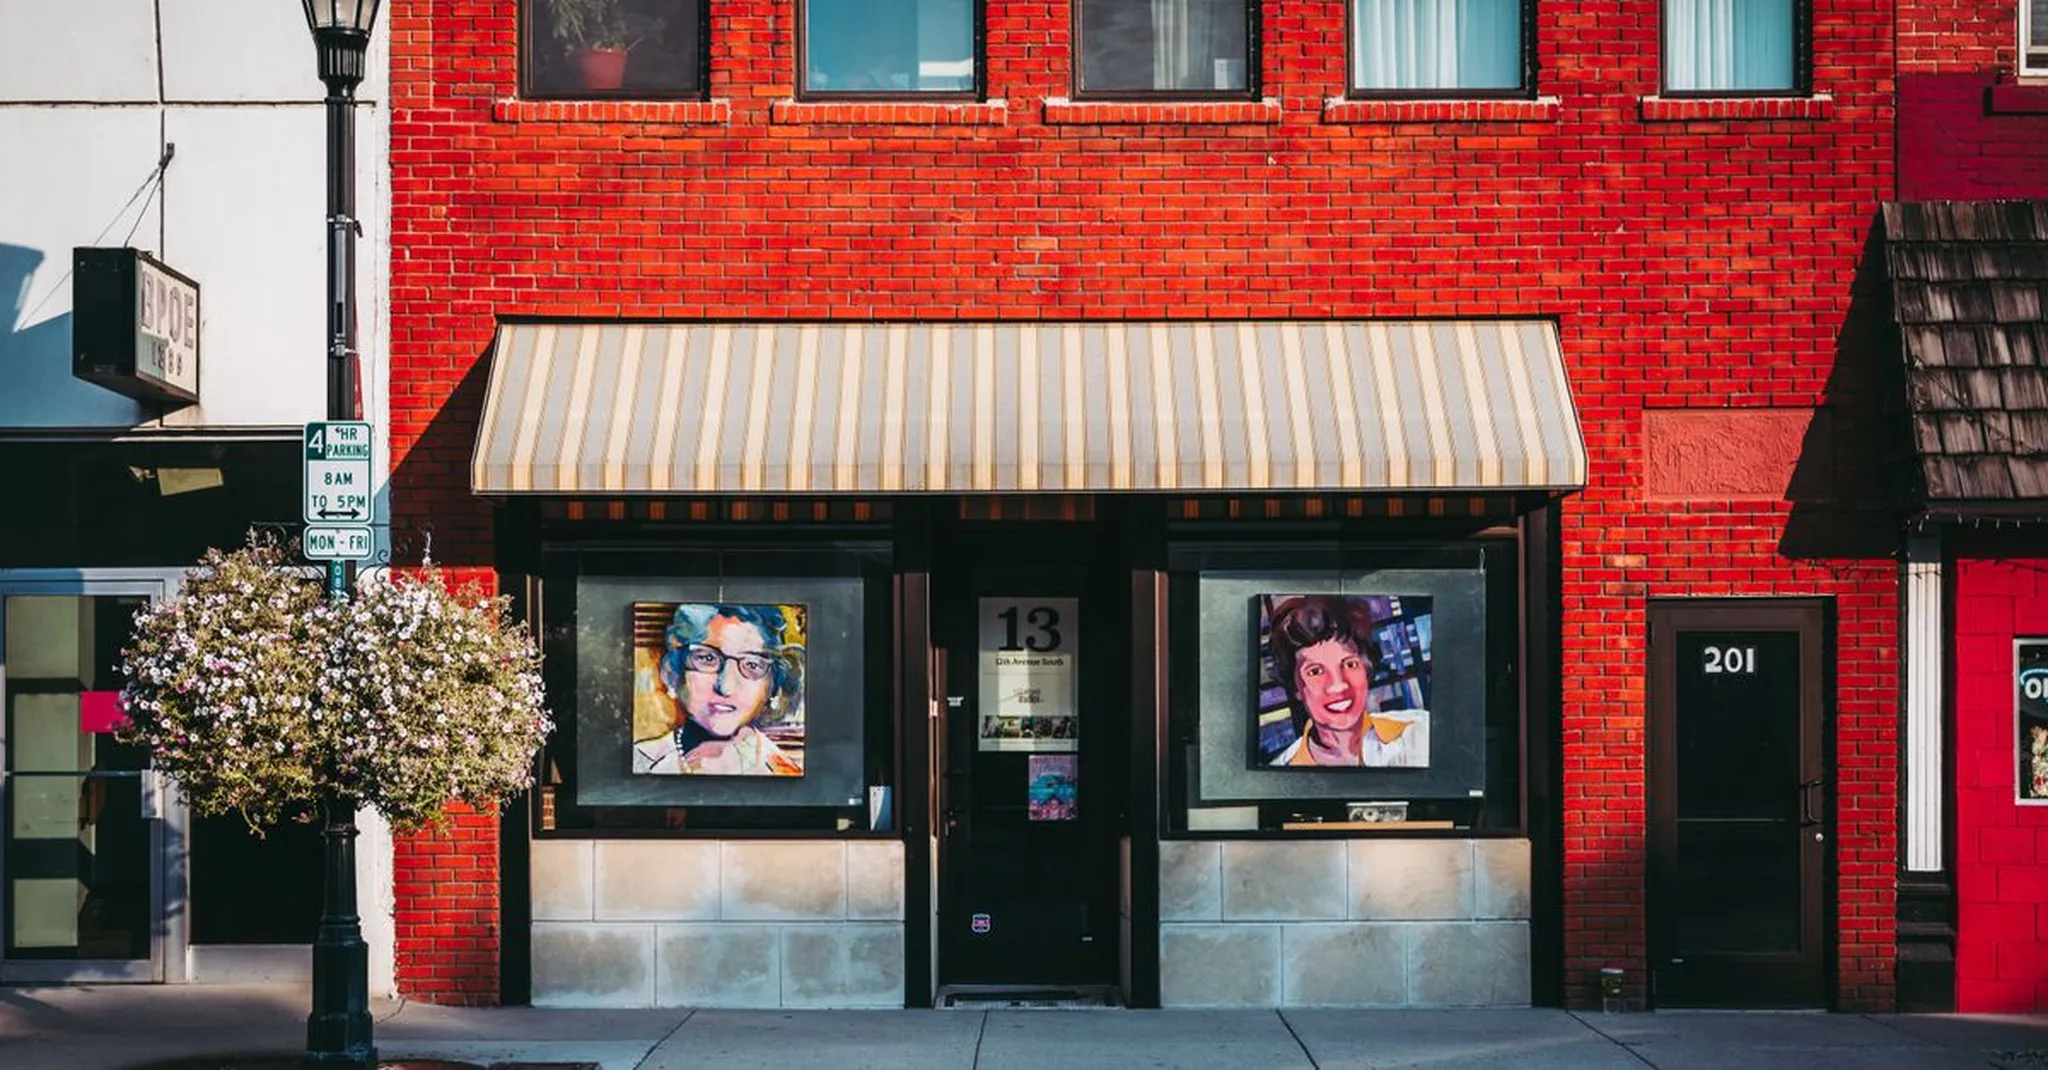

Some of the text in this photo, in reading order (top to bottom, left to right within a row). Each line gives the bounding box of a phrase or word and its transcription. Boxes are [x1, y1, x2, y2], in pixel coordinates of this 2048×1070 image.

[308, 429, 324, 453] 4
[340, 428, 358, 440] HR
[327, 443, 369, 456] PARKING
[311, 495, 328, 508] TO
[309, 535, 335, 550] MON
[349, 535, 368, 550] FRI
[997, 605, 1062, 652] 13
[1042, 657, 1065, 667] South
[1704, 645, 1755, 673] 201
